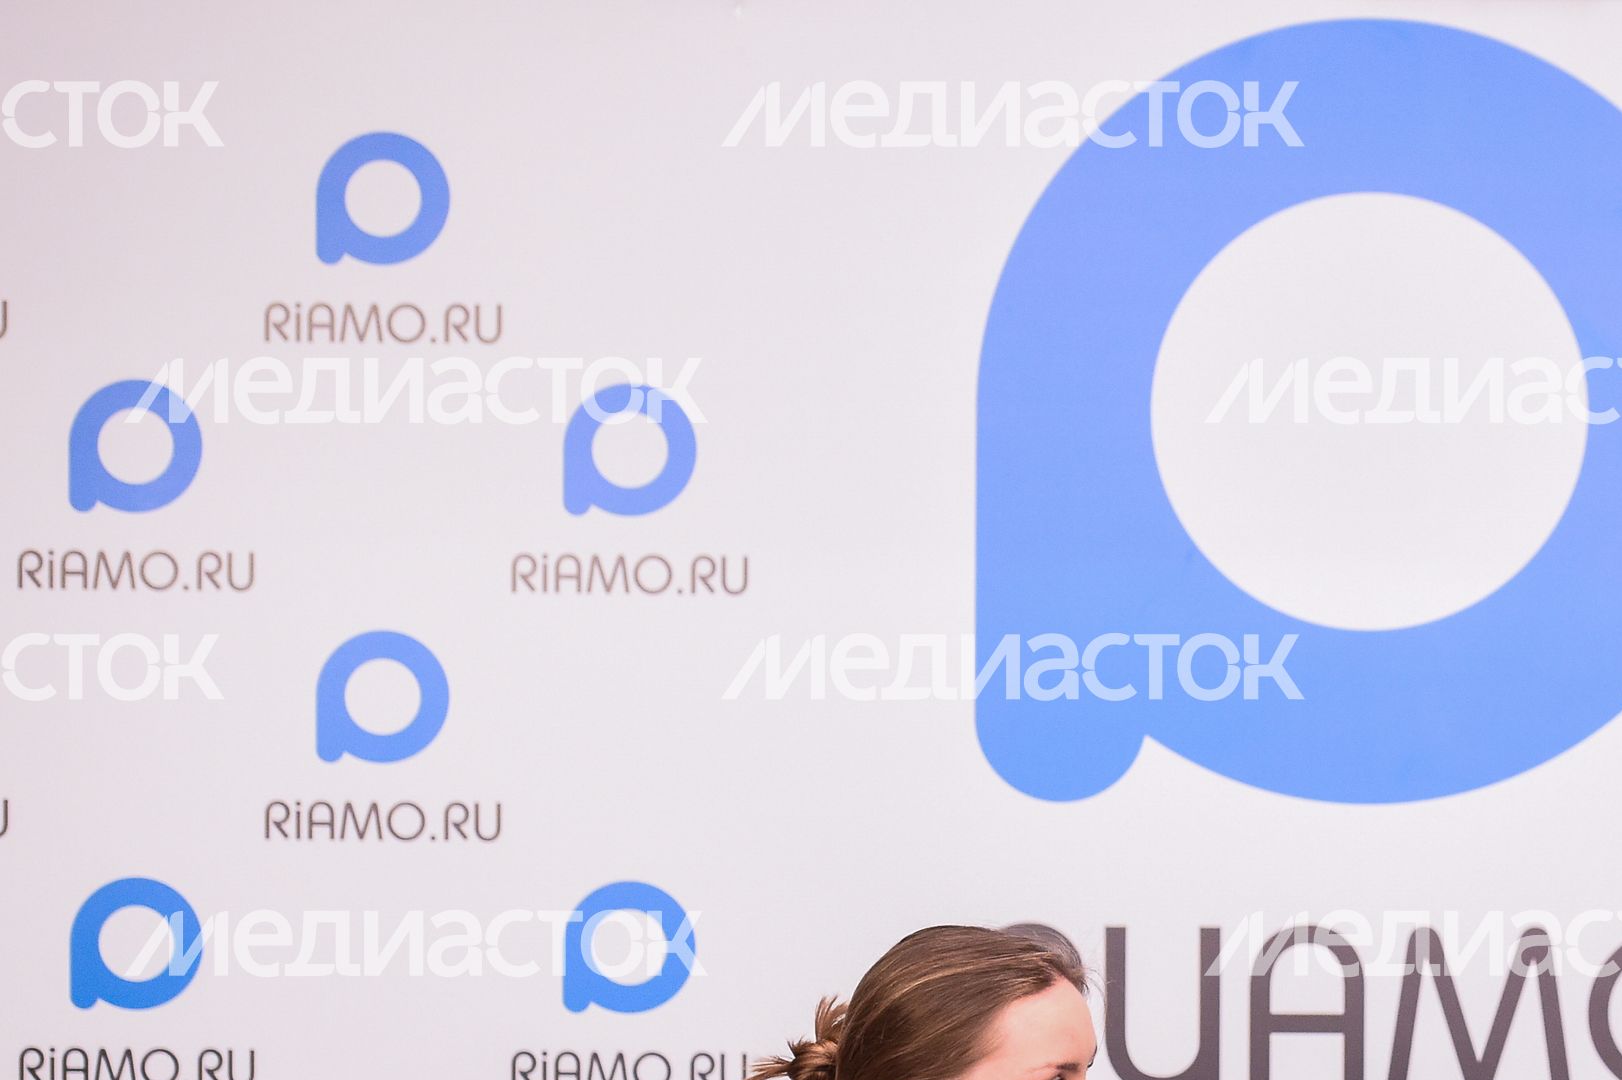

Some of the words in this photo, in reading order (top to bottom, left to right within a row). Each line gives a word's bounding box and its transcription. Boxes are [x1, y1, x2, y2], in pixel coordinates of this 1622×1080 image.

[264, 302, 502, 344] RiAMO.RU
[17, 550, 255, 591] RiAMO.RU
[510, 554, 749, 595] RiAMO.RU
[264, 801, 502, 842] RiAMO.RU
